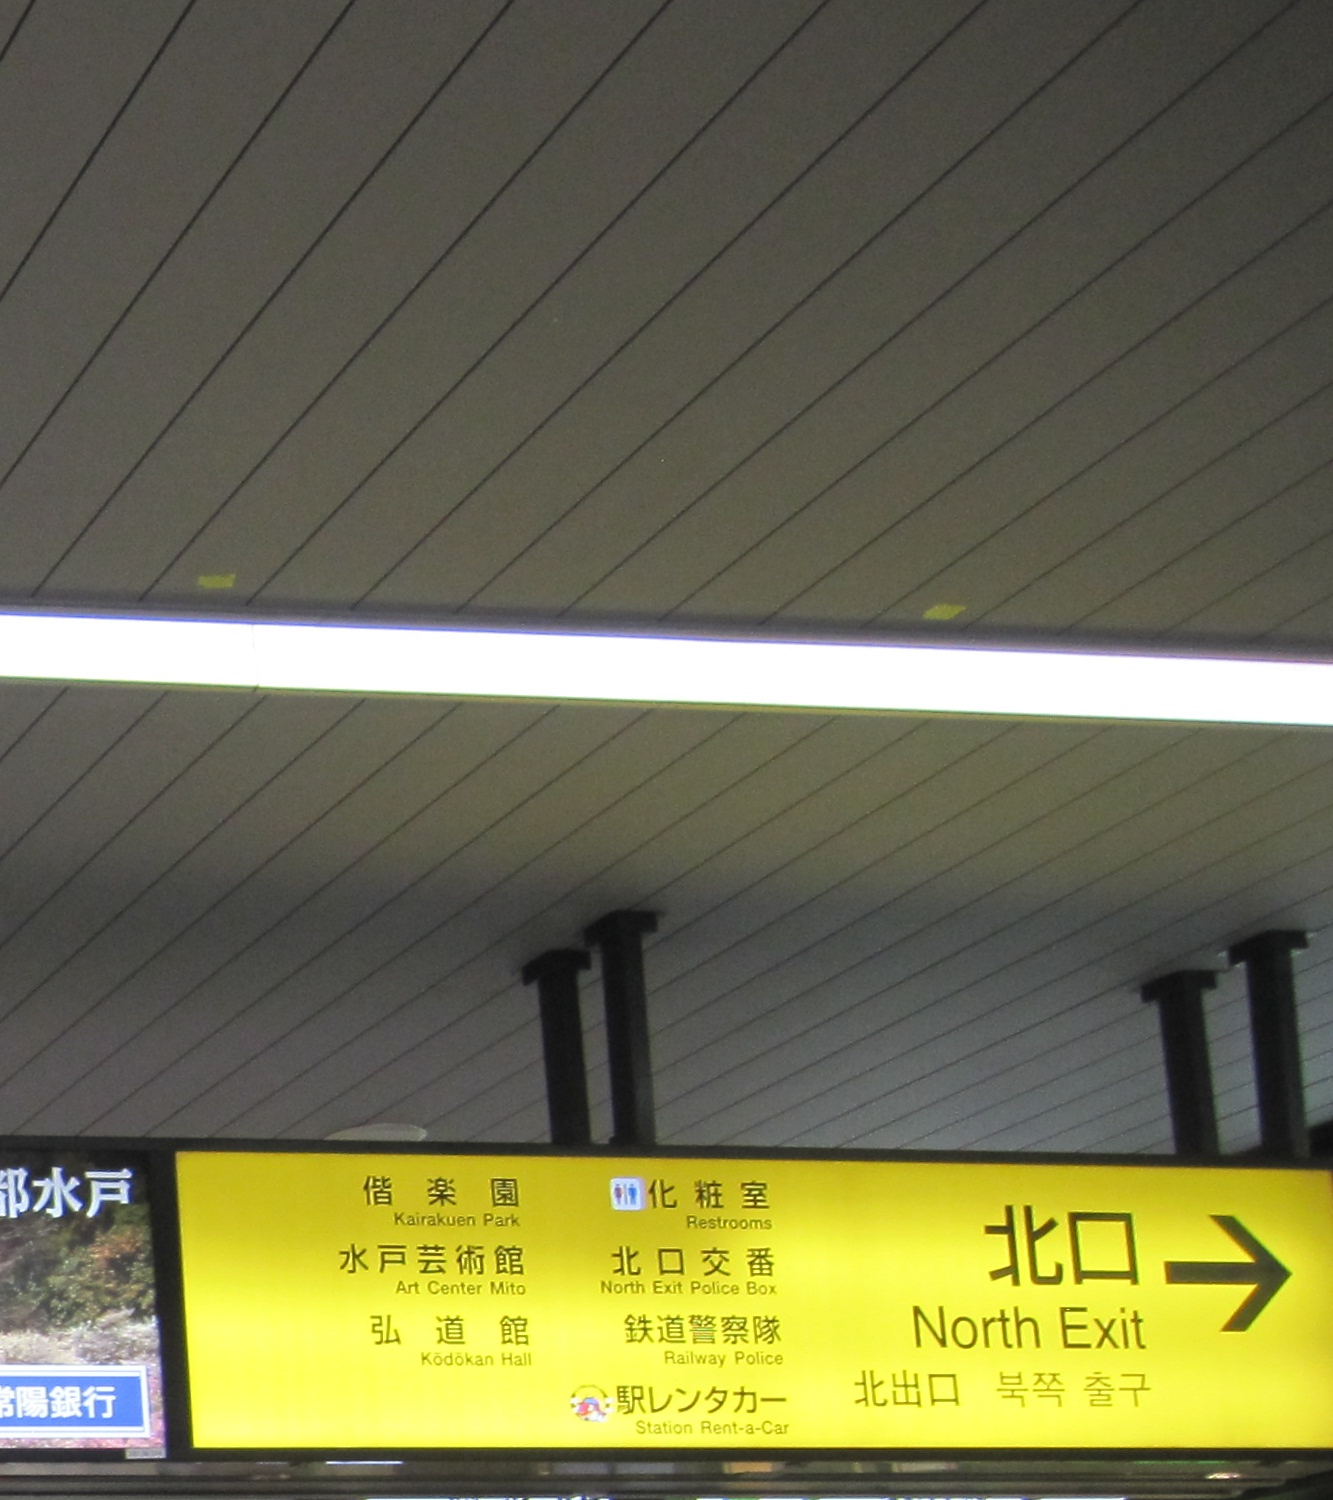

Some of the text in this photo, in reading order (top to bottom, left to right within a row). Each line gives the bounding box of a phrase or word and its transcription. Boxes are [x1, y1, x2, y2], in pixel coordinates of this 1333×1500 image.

[363, 1176, 520, 1208] 偕楽園
[646, 1179, 771, 1211] 化粧室
[393, 1212, 521, 1228] Kairakuen Park
[685, 1215, 774, 1231] Restrooms
[337, 1244, 526, 1278] 水戸芸術館
[983, 1204, 1140, 1287] 北口
[611, 1247, 777, 1278] 北口交番
[395, 1281, 527, 1297] Art Center Mito
[600, 1280, 778, 1297] North Exit Police Box
[369, 1314, 530, 1347] 弘道館
[623, 1313, 783, 1346] 鉄道警察隊
[912, 1304, 1147, 1350] North Exit
[420, 1350, 532, 1367] Kōdōkan Hall
[663, 1351, 785, 1369] Railway Police
[616, 1385, 788, 1416] 駅レンタカー
[853, 1368, 961, 1410] 北出口
[994, 1370, 1152, 1410] 북쪽 출구
[634, 1419, 791, 1437] Station Rent-a-Car
